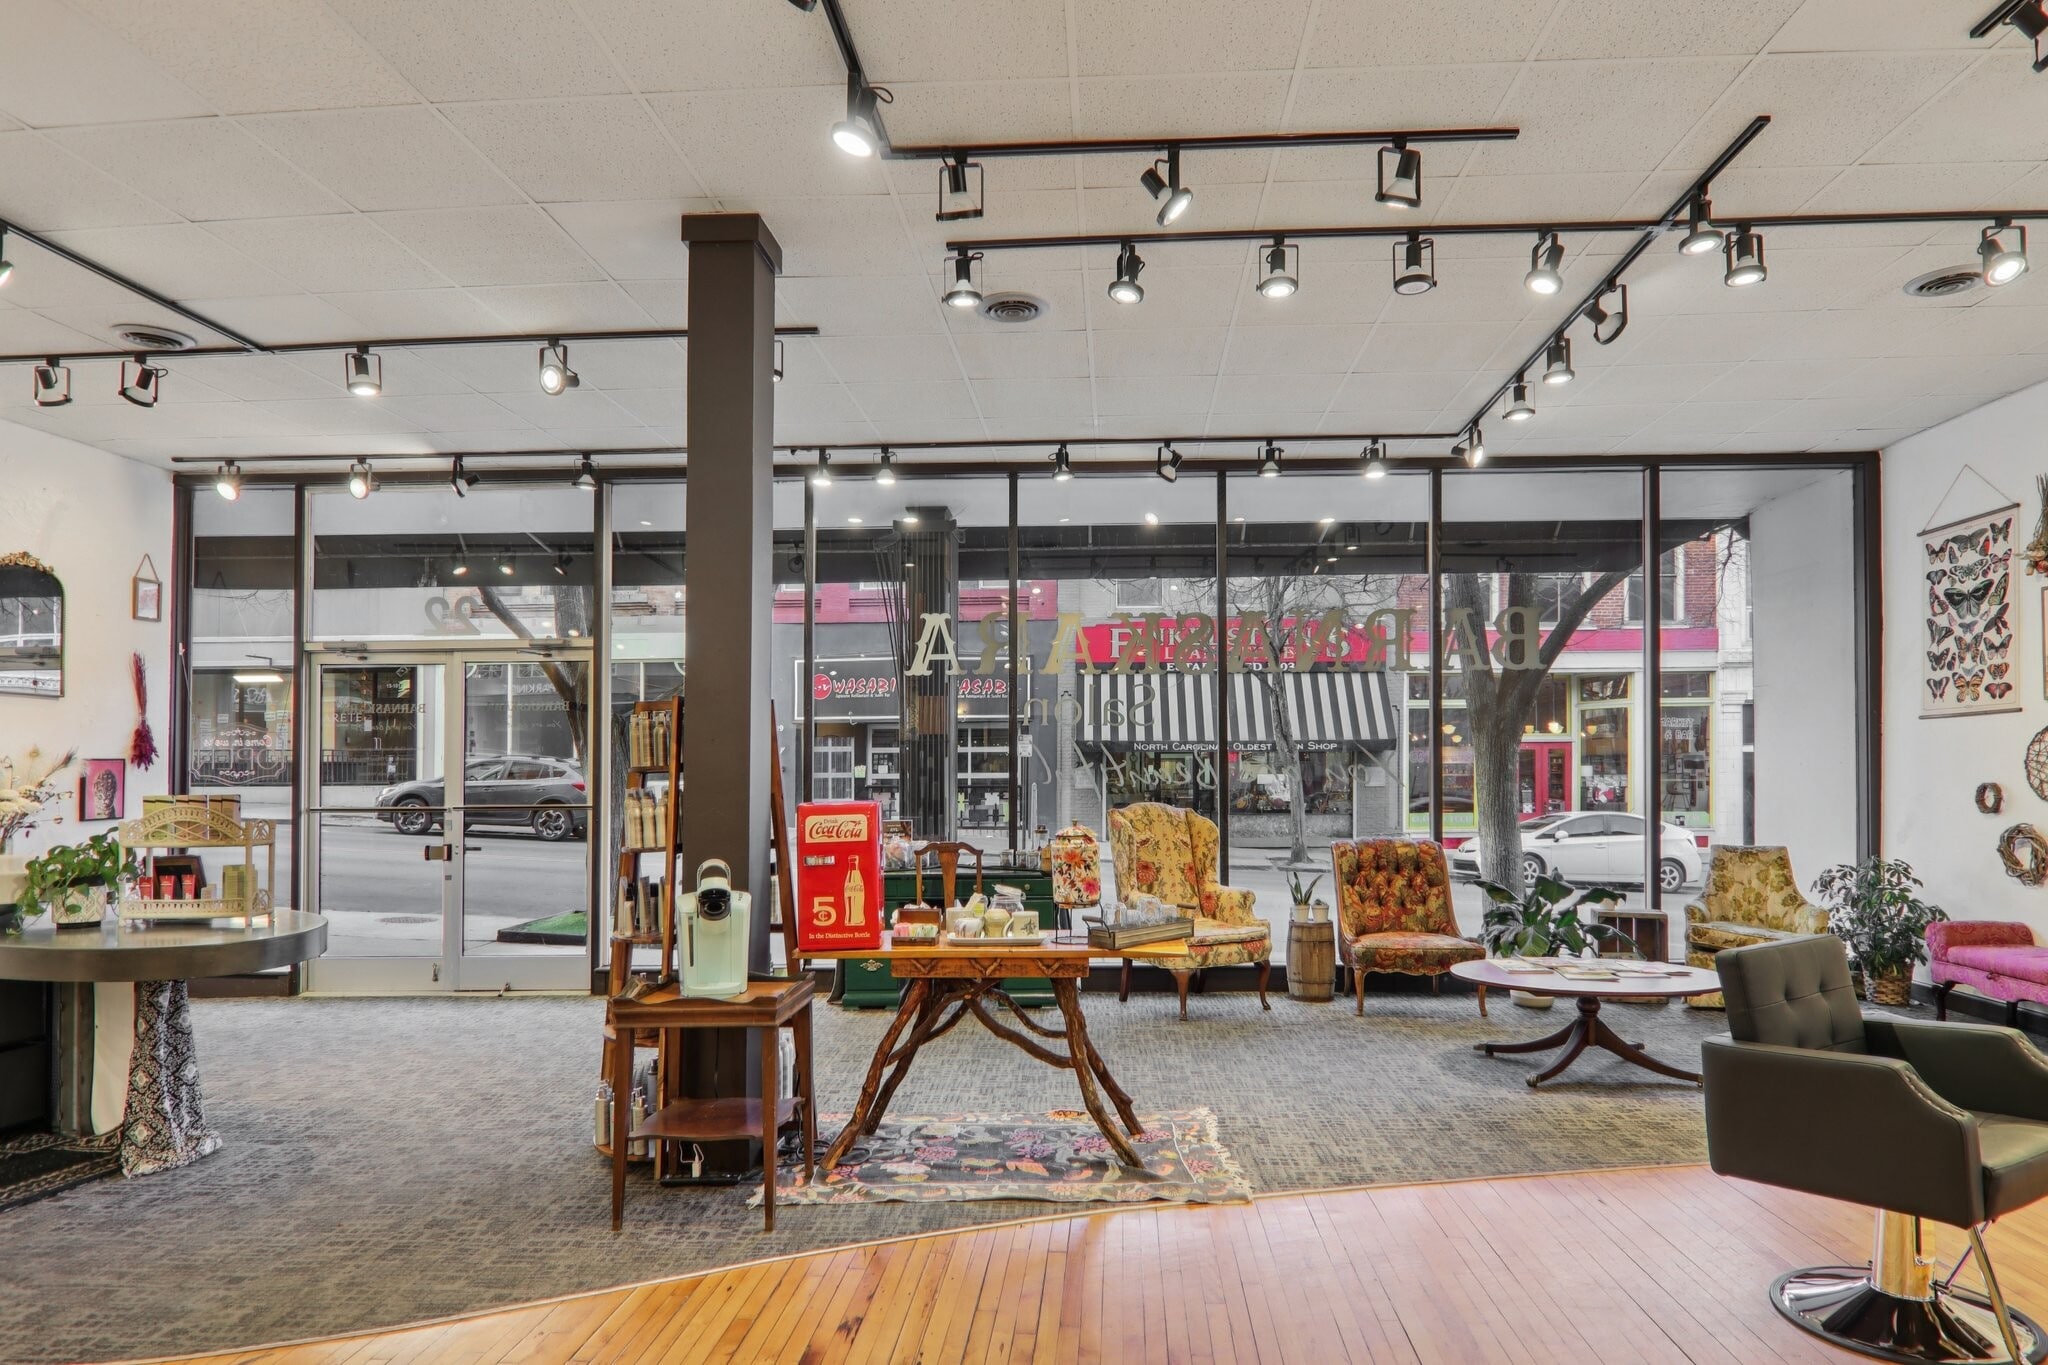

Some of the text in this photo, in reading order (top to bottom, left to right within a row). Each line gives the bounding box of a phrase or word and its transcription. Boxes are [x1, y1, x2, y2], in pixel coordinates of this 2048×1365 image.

[833, 677, 897, 694] WASABI
[958, 678, 1009, 694] ASAB
[1133, 741, 1168, 751] NORTH
[1233, 741, 1272, 751] OLDEST
[1308, 741, 1338, 751] SHOP
[825, 931, 854, 939] Distinctive
[854, 930, 871, 938] Bottle
